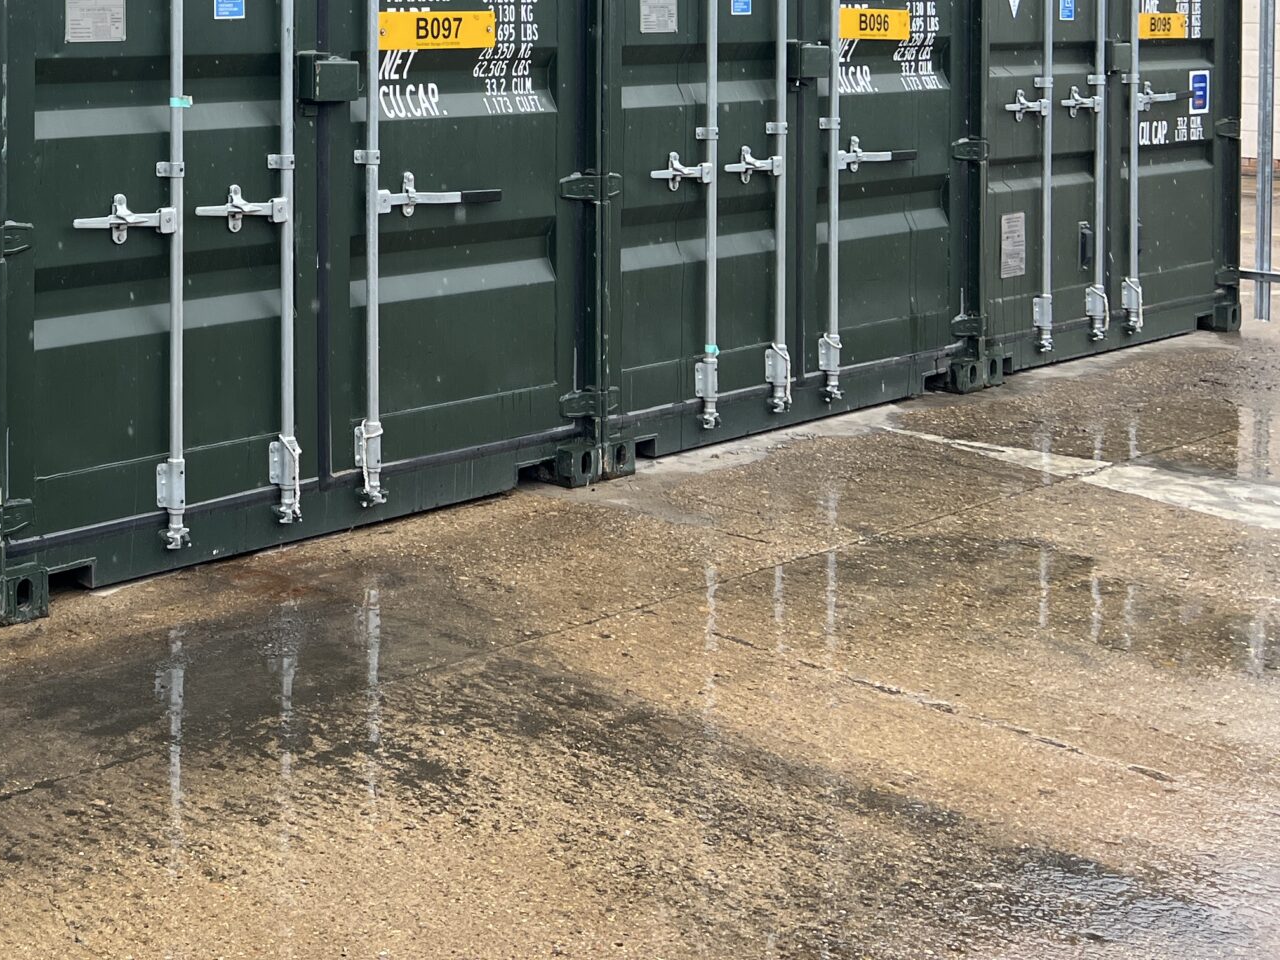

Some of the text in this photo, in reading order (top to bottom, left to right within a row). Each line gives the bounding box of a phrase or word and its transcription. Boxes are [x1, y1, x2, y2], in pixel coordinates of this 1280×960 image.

[521, 4, 533, 22] KG
[927, 1, 936, 16] KG
[416, 17, 463, 40] B097
[859, 13, 889, 31] B096
[926, 17, 939, 31] LBS
[1149, 17, 1171, 32] B095
[521, 23, 539, 41] LBS
[518, 43, 533, 59] KG
[379, 49, 418, 80] NET
[512, 60, 531, 76] LBS
[485, 78, 507, 95] 33.2
[379, 83, 448, 118] CU.CAP.
